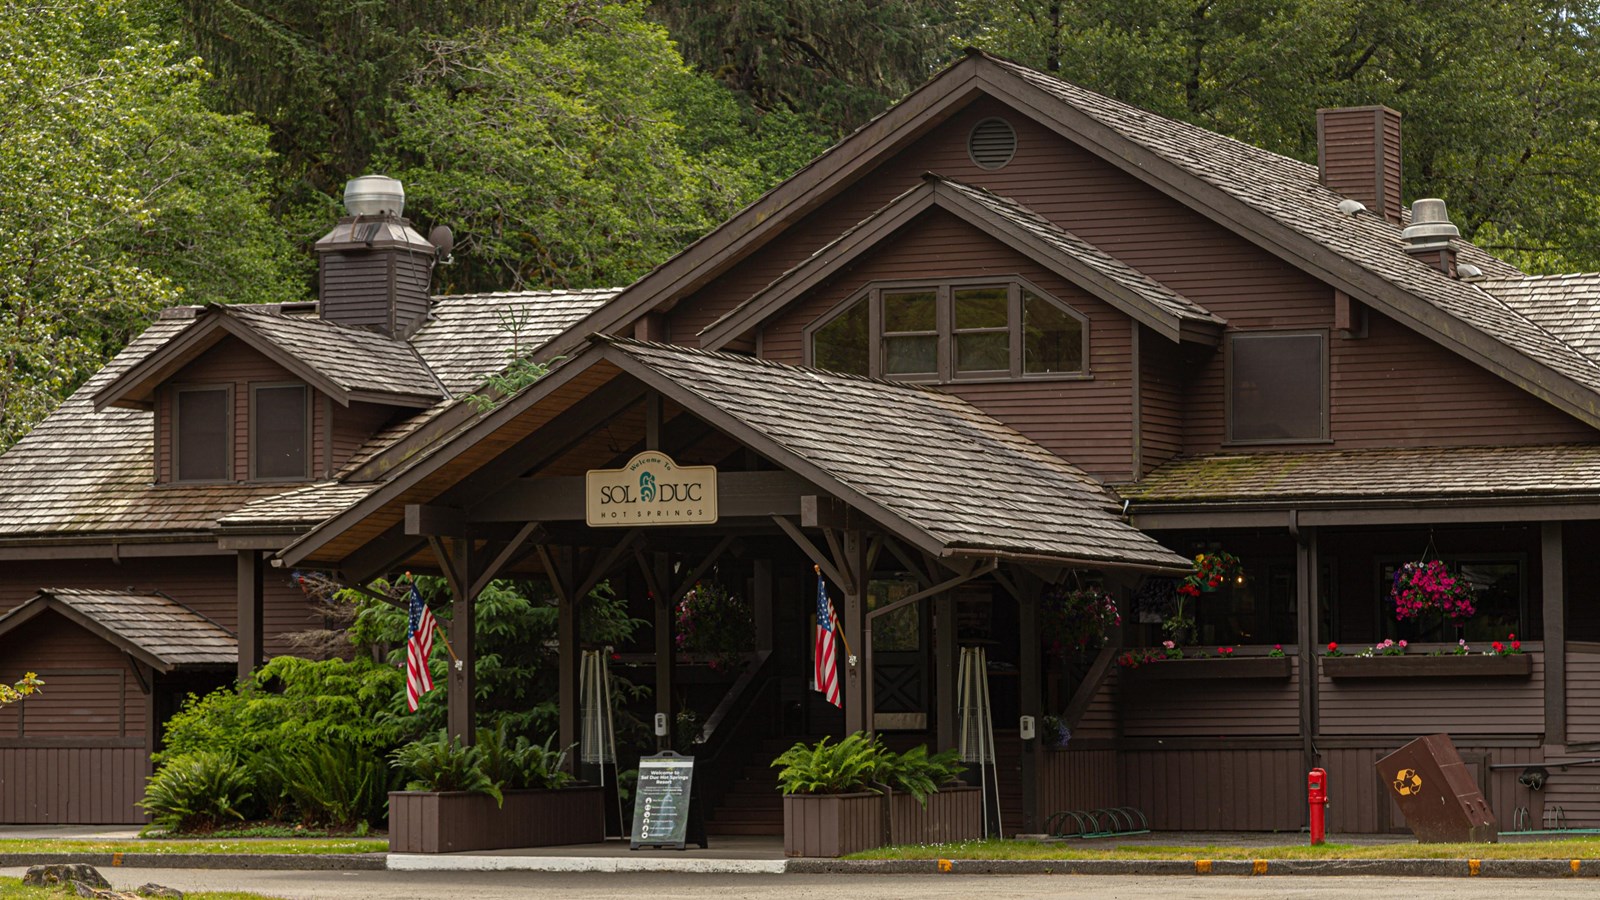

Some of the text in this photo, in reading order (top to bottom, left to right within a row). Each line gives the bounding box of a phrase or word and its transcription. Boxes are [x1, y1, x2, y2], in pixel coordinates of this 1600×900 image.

[630, 457, 672, 472] Welcome To
[601, 483, 702, 504] SOL DUC
[637, 509, 703, 517] SPRINGS
